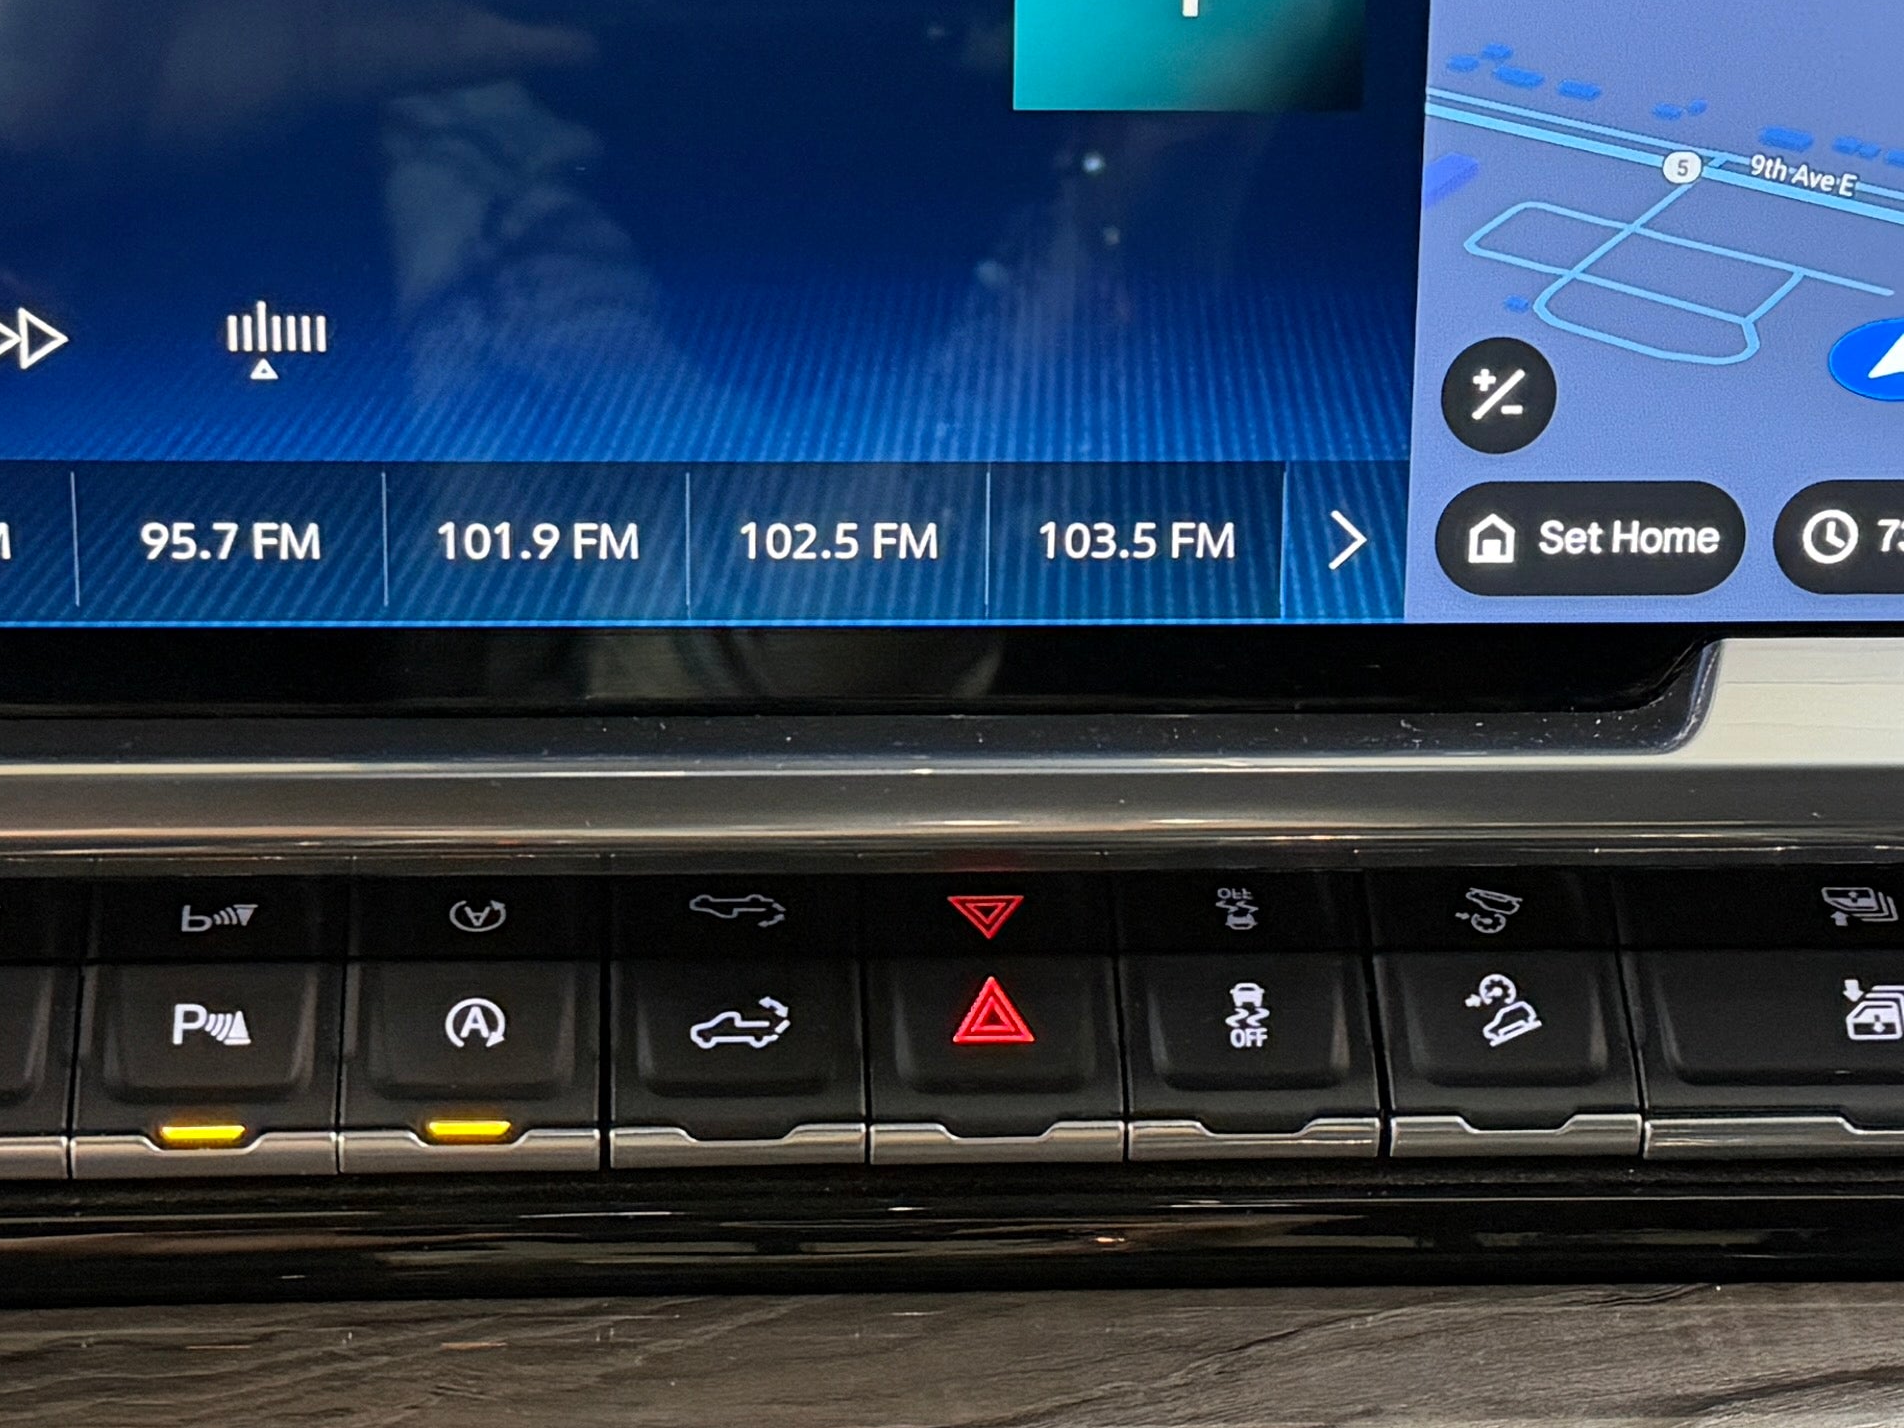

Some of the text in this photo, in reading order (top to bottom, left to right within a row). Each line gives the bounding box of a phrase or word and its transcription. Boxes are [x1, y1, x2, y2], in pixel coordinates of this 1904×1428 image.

[1677, 159, 1690, 177] 5
[1748, 153, 1859, 198] 9th Ave E
[140, 521, 322, 561] 95.7 FM
[437, 521, 640, 561] 101.9 FM
[739, 521, 939, 561] 102.5 FM
[1039, 520, 1236, 561] 103.5 FM
[1538, 519, 1721, 555] Set Home
[1229, 1027, 1269, 1049] OFF
